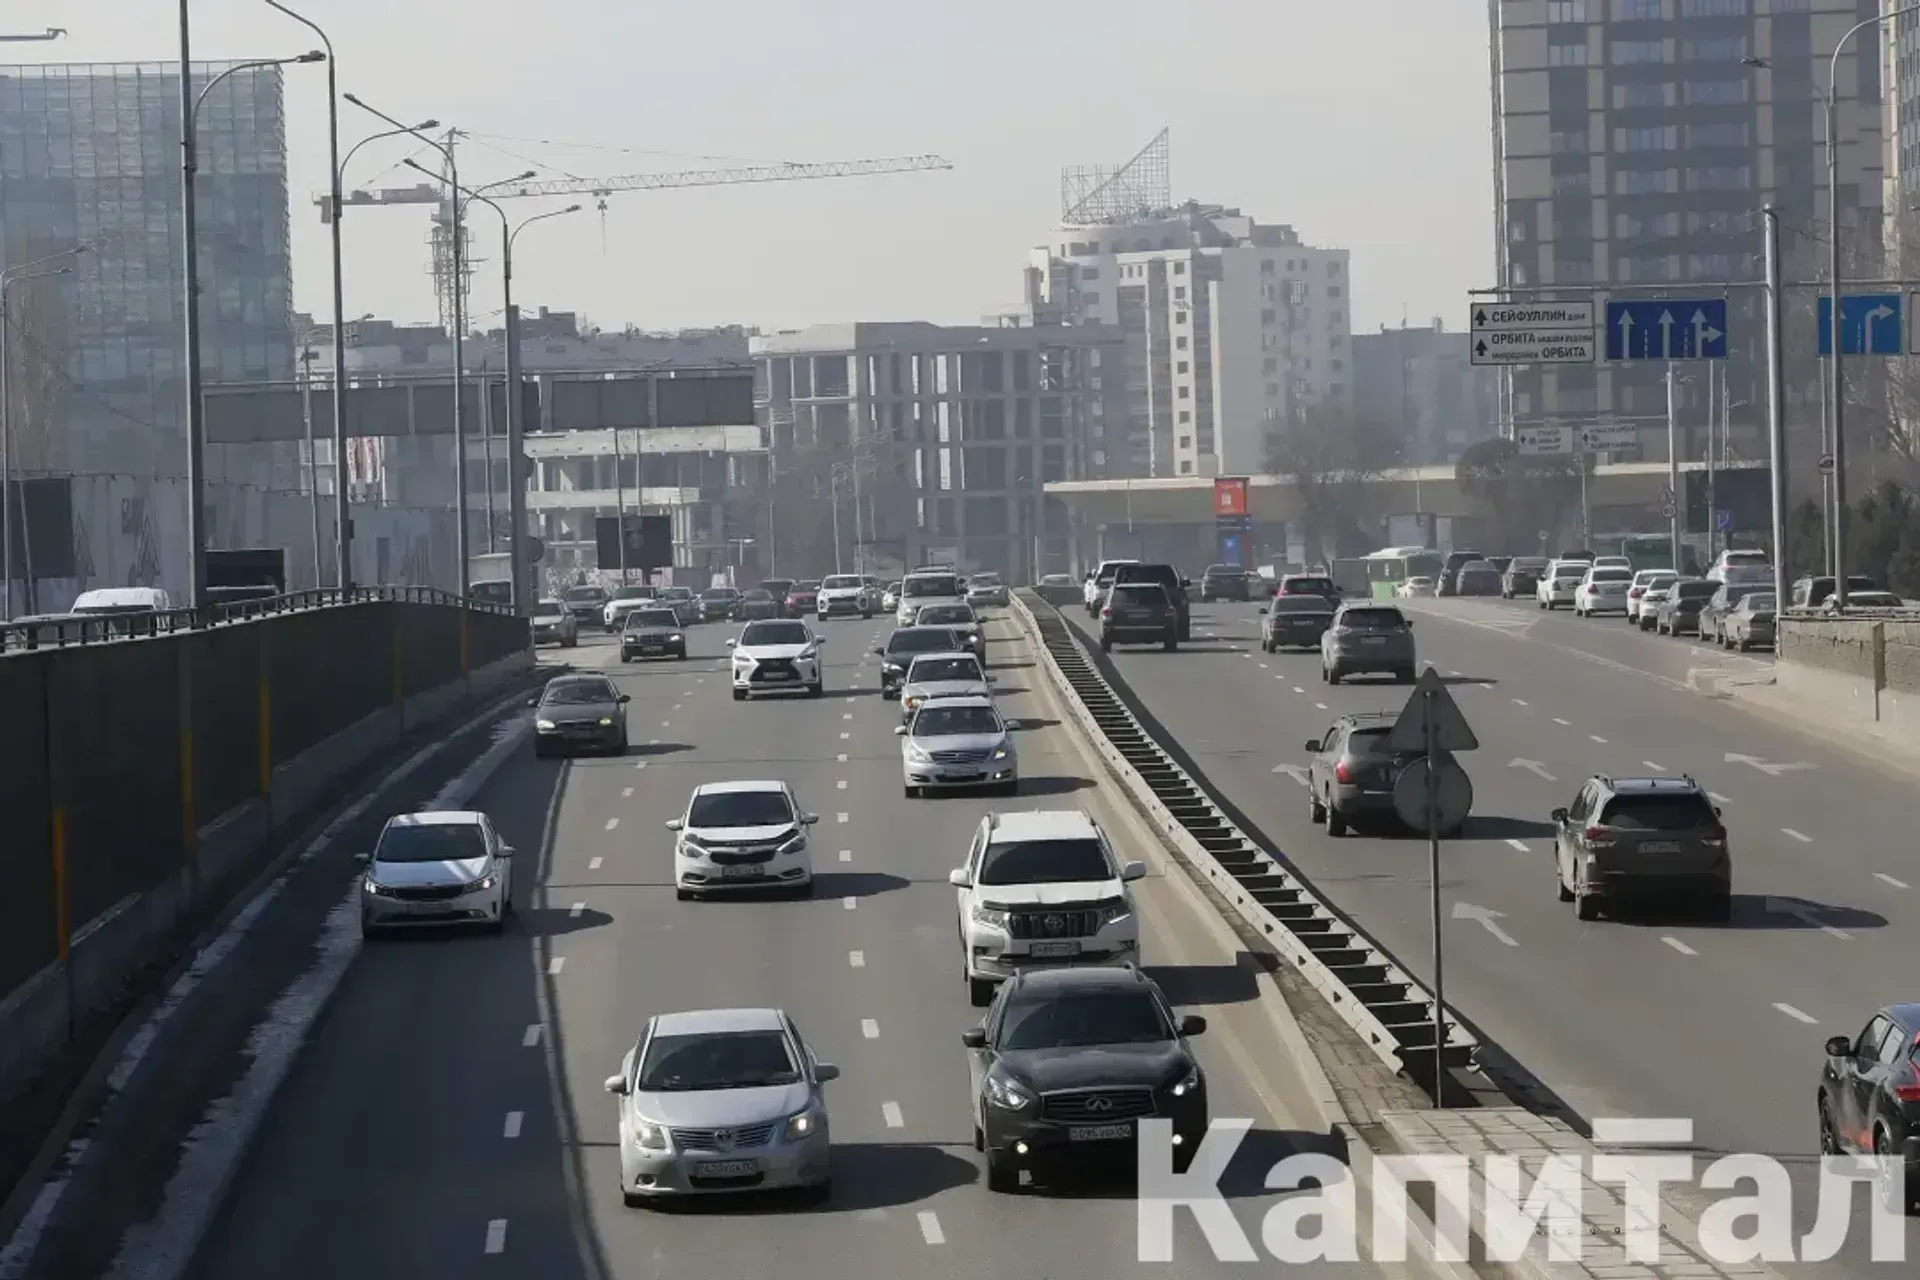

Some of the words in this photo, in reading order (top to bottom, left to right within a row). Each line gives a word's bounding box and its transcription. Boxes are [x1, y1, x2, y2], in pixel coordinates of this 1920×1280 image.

[1491, 309, 1566, 323] СЕЙФУЛЛИН
[1491, 332, 1536, 345] ОРБИТА
[1541, 346, 1587, 359] ОРБИТА
